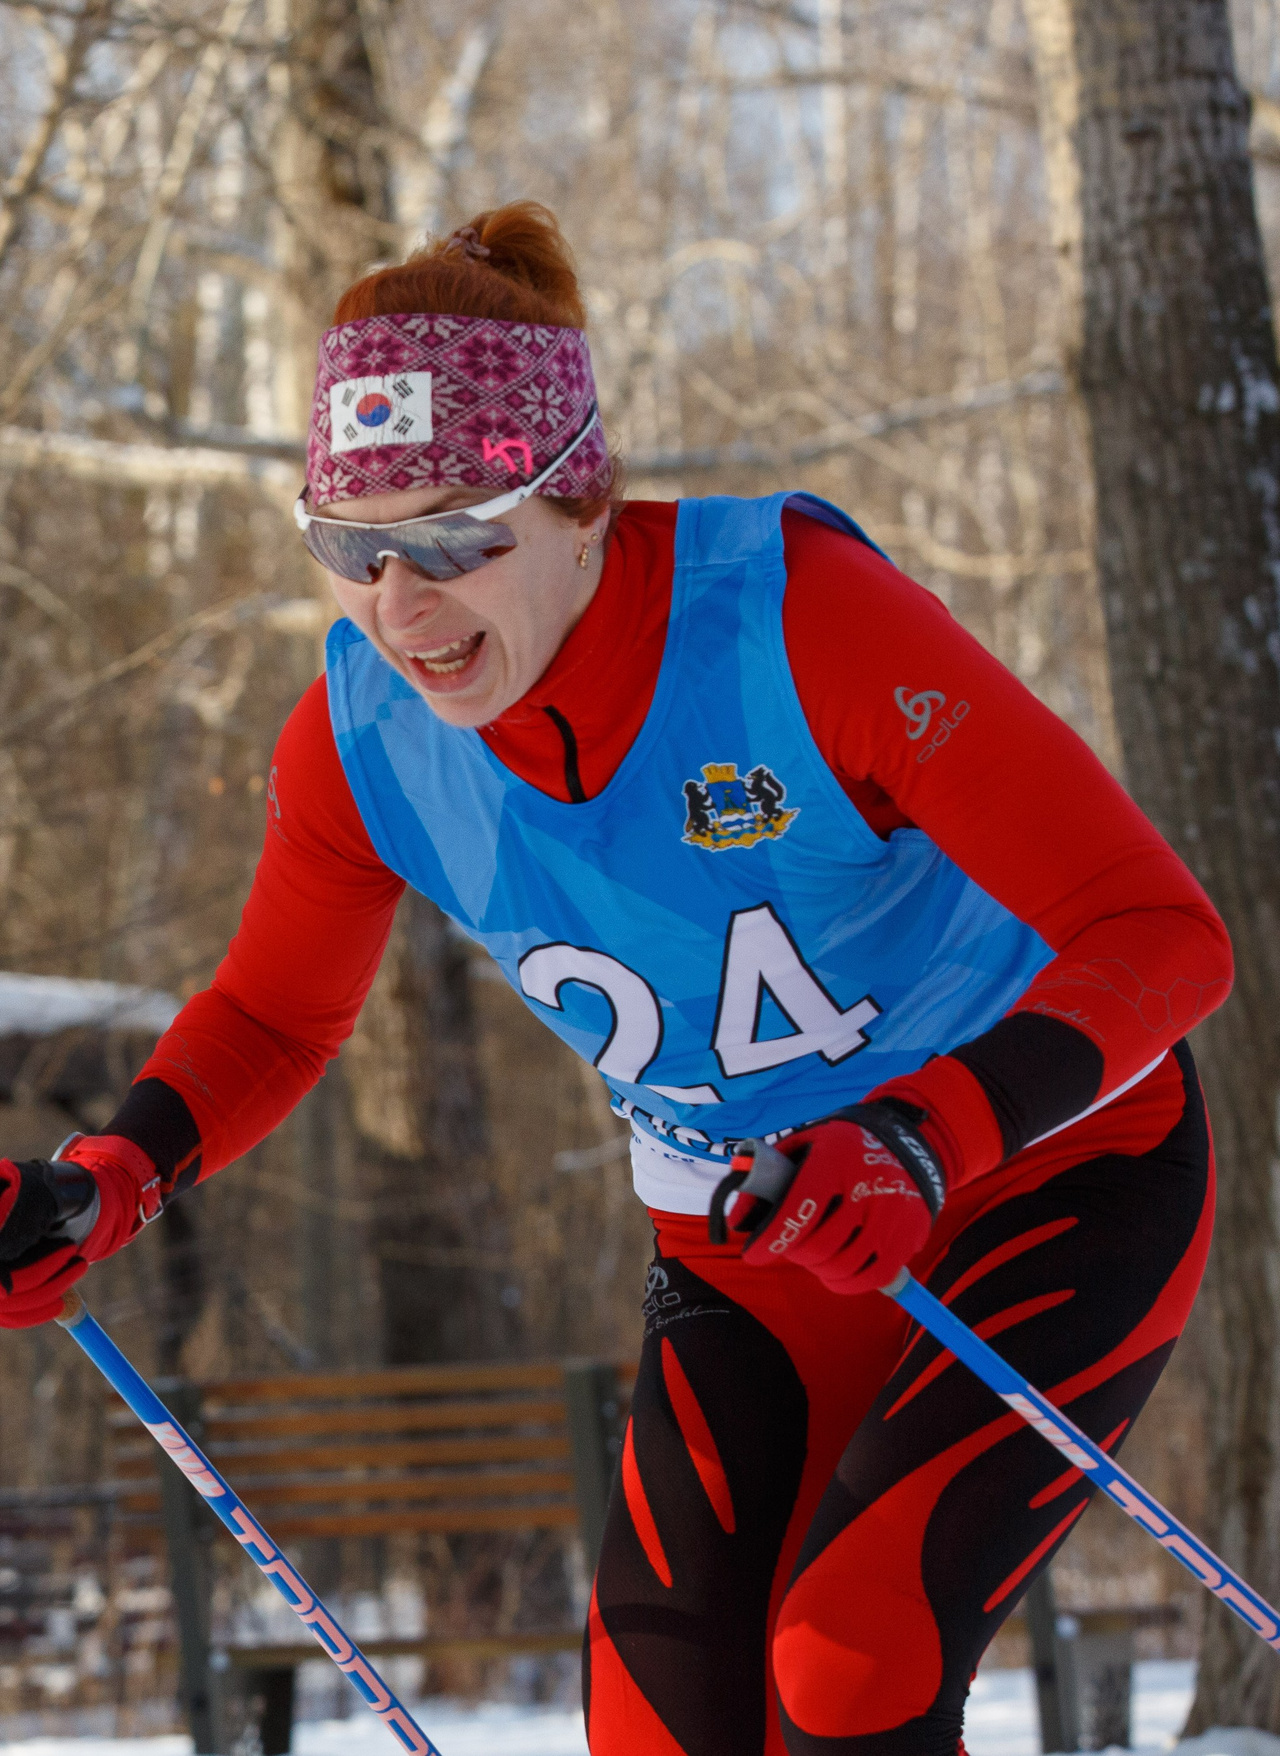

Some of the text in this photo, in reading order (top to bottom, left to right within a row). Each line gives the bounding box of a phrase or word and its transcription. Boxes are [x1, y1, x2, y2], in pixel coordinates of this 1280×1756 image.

[917, 700, 971, 763] odlo
[518, 900, 883, 1107] 24
[769, 1198, 817, 1254] odlo
